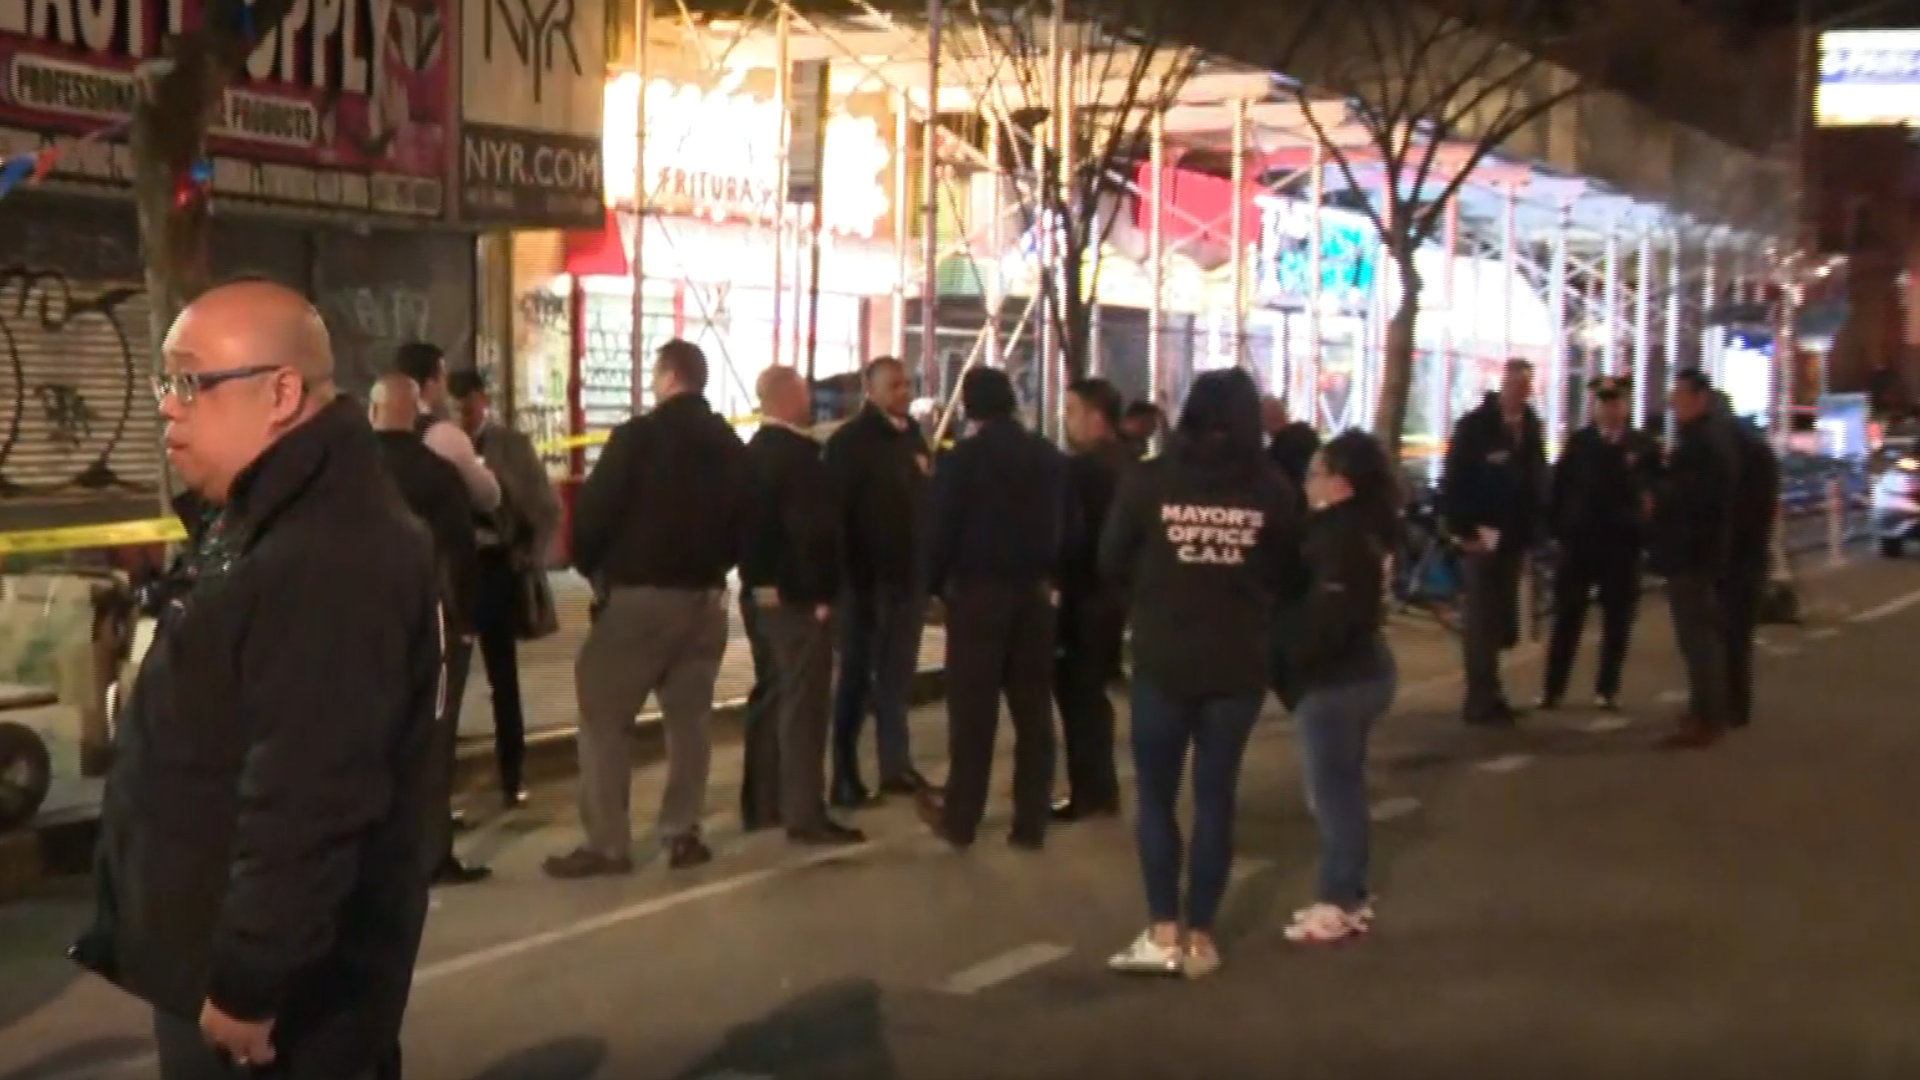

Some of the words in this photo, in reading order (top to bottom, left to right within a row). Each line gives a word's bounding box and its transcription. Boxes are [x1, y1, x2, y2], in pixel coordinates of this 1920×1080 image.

[484, 0, 584, 104] NYR
[17, 63, 138, 113] PROFESSIONA
[231, 95, 313, 141] PRODUCTS
[464, 136, 600, 190] NYR.COM
[1161, 504, 1264, 528] MAYOR'S
[1166, 525, 1257, 547] OFFICE
